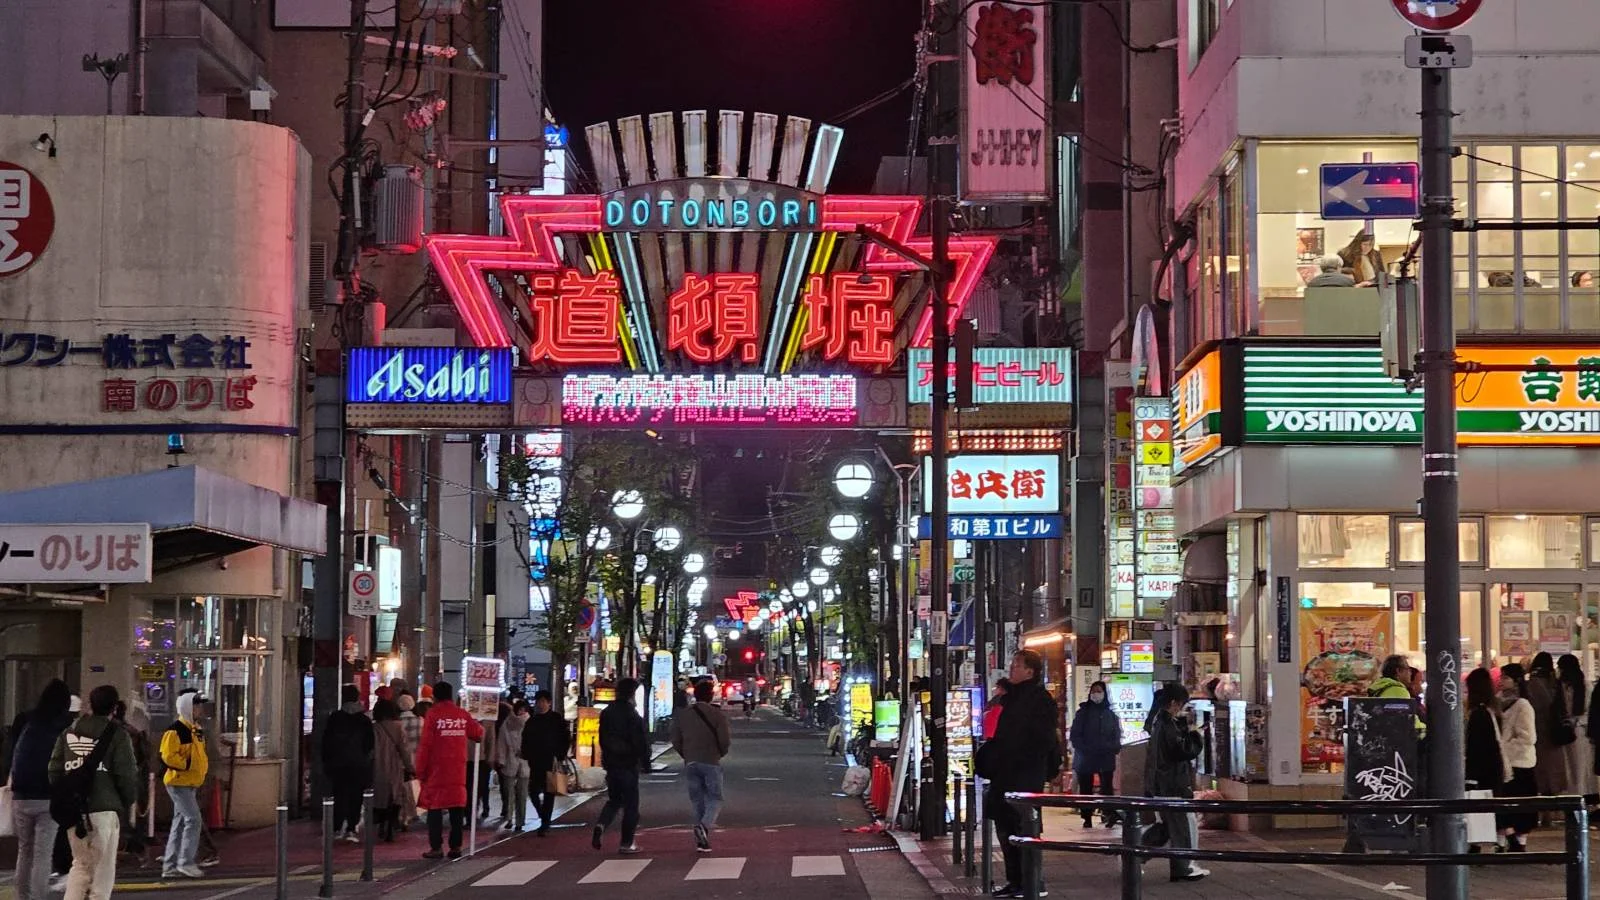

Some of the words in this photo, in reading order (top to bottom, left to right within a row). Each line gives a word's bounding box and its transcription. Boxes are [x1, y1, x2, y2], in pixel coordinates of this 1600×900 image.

[606, 199, 817, 227] DOTONBORI
[531, 269, 894, 363] 道頓堀
[0, 333, 252, 369] クシー株式会社
[366, 349, 491, 398] Asahi
[1266, 410, 1416, 432] YOSHINOYA
[1519, 410, 1600, 432] YOSHI
[950, 517, 1051, 537] 和第Ⅱビル
[0, 534, 140, 571] ーのりば
[436, 718, 468, 729] カラオケ
[65, 757, 108, 772] adi
